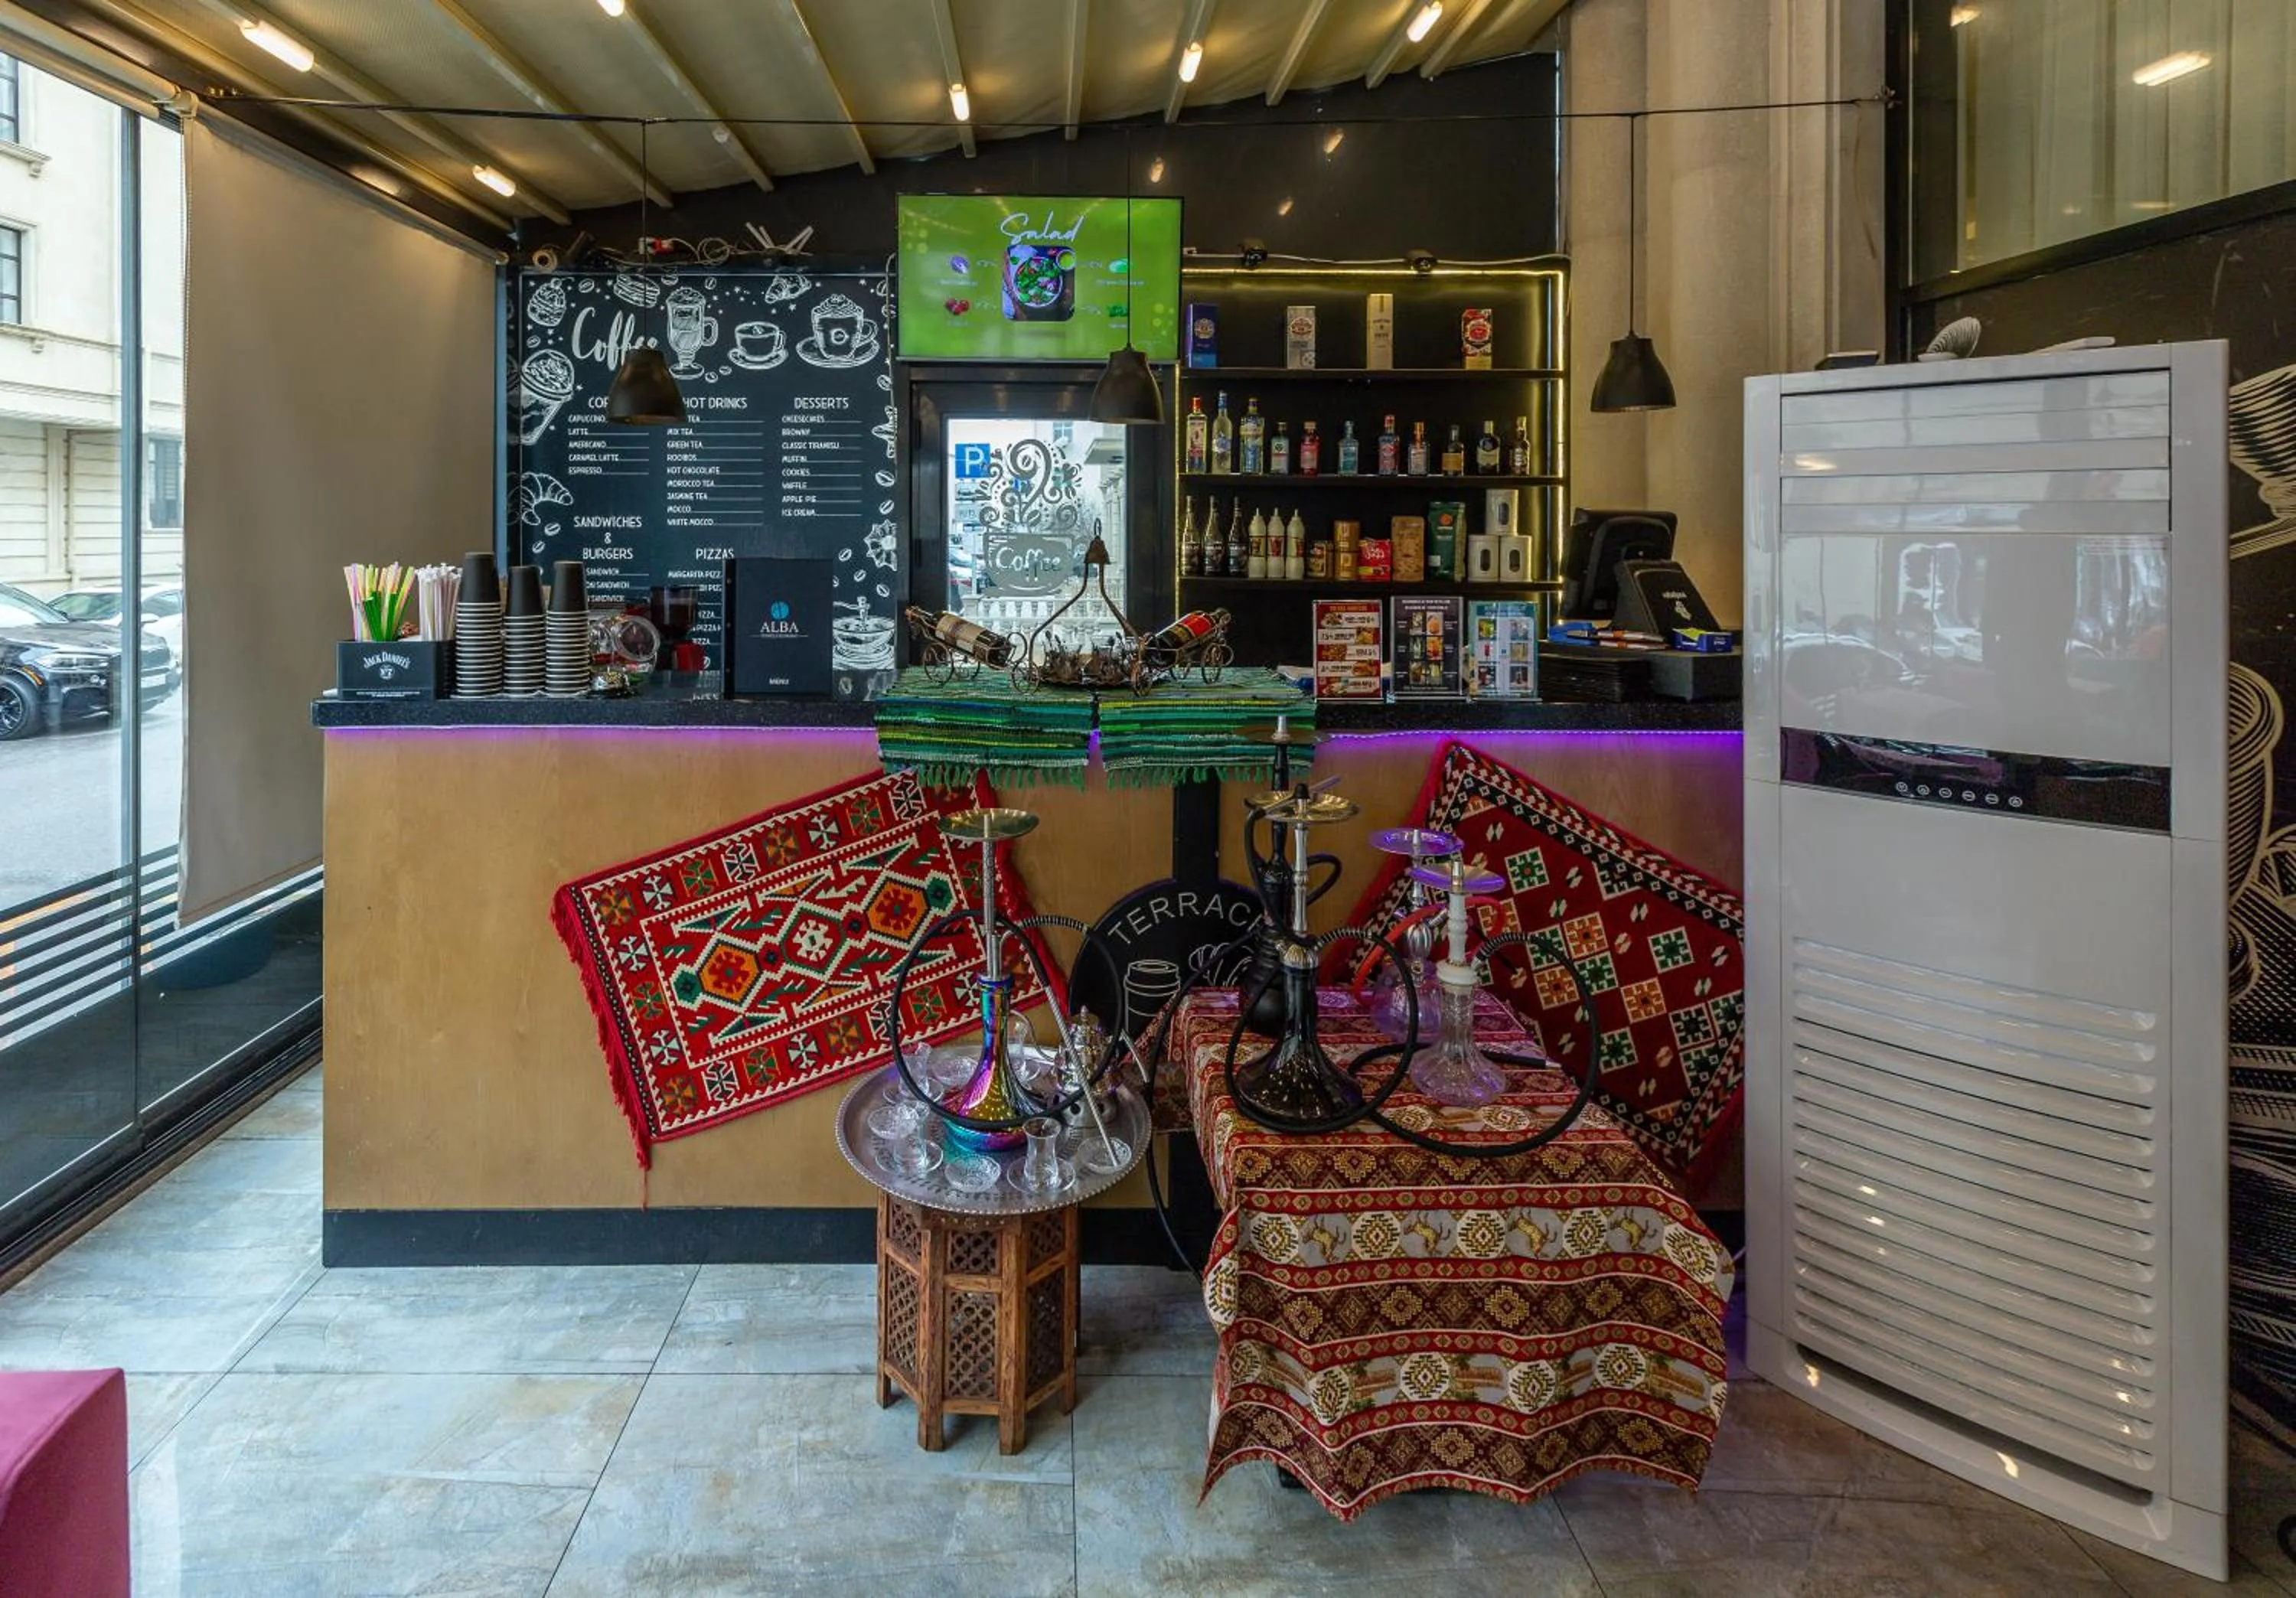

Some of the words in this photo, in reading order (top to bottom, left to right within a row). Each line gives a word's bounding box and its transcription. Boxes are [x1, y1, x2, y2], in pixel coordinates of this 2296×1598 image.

[1000, 208, 1086, 244] Salad
[709, 397, 747, 409] DRINKS
[794, 397, 850, 409] DESSERTS
[966, 446, 984, 475] P
[781, 468, 810, 477] COOKIES
[574, 516, 642, 528] SANDWICHES
[604, 532, 612, 544] &
[582, 548, 634, 560] BURGERS
[696, 547, 735, 559] PIZZAS
[996, 546, 1062, 582] Coffee
[760, 621, 799, 633] ALBA
